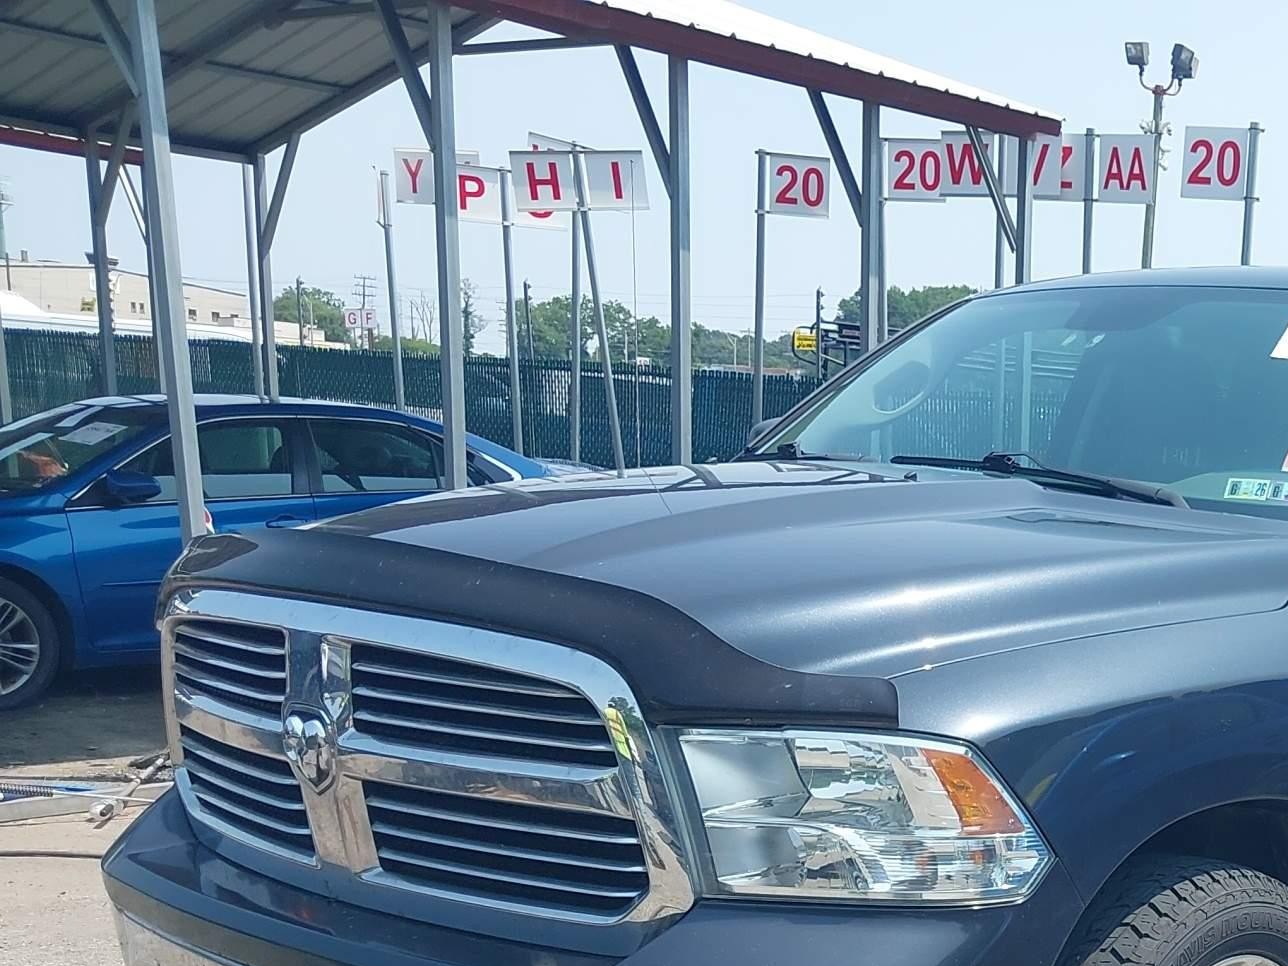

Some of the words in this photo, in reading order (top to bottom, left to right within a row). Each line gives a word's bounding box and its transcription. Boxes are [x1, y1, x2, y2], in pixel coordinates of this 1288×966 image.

[401, 158, 423, 194] Y
[526, 162, 562, 201] H
[610, 161, 624, 201] I
[893, 149, 941, 192] 20
[946, 143, 990, 186] W
[1103, 146, 1148, 191] AA
[1187, 139, 1241, 187] 20
[457, 174, 486, 210] P
[775, 164, 825, 208] 20
[348, 312, 357, 325] G
[366, 312, 373, 325] F
